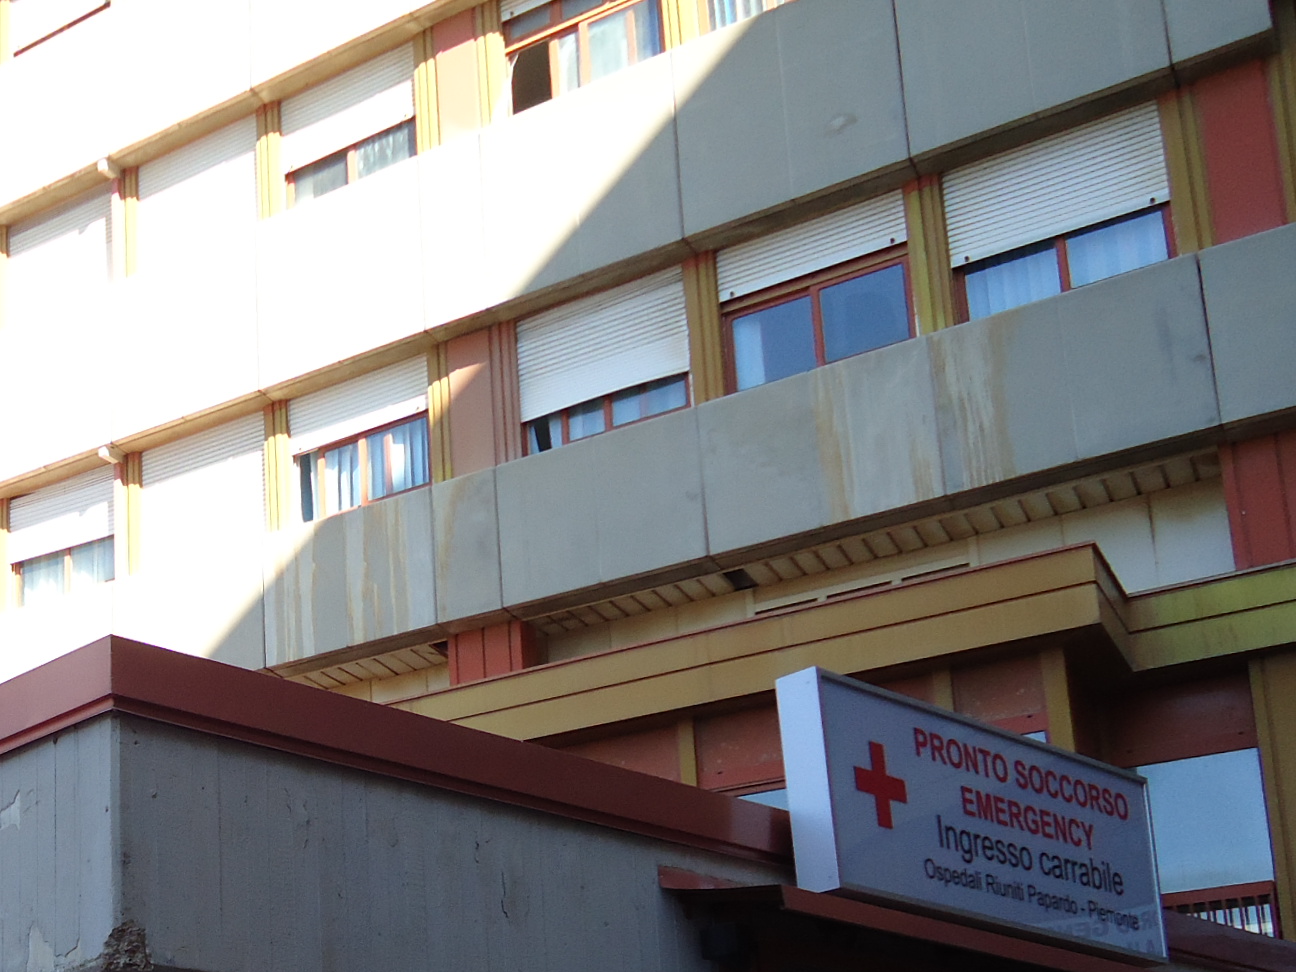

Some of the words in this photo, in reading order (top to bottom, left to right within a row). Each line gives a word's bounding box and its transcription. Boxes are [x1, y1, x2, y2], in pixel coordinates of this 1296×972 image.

[913, 727, 1009, 783] PRONTO
[1014, 760, 1129, 821] SOCCORSO
[936, 814, 1033, 871] Ingresso
[1039, 852, 1125, 896] carrabile
[960, 785, 1094, 850] EMERGENCY
[924, 858, 983, 890] Ospedali
[986, 873, 1025, 901] Riuniti
[1028, 885, 1078, 914] Papardo
[1088, 900, 1140, 931] Piemonte
